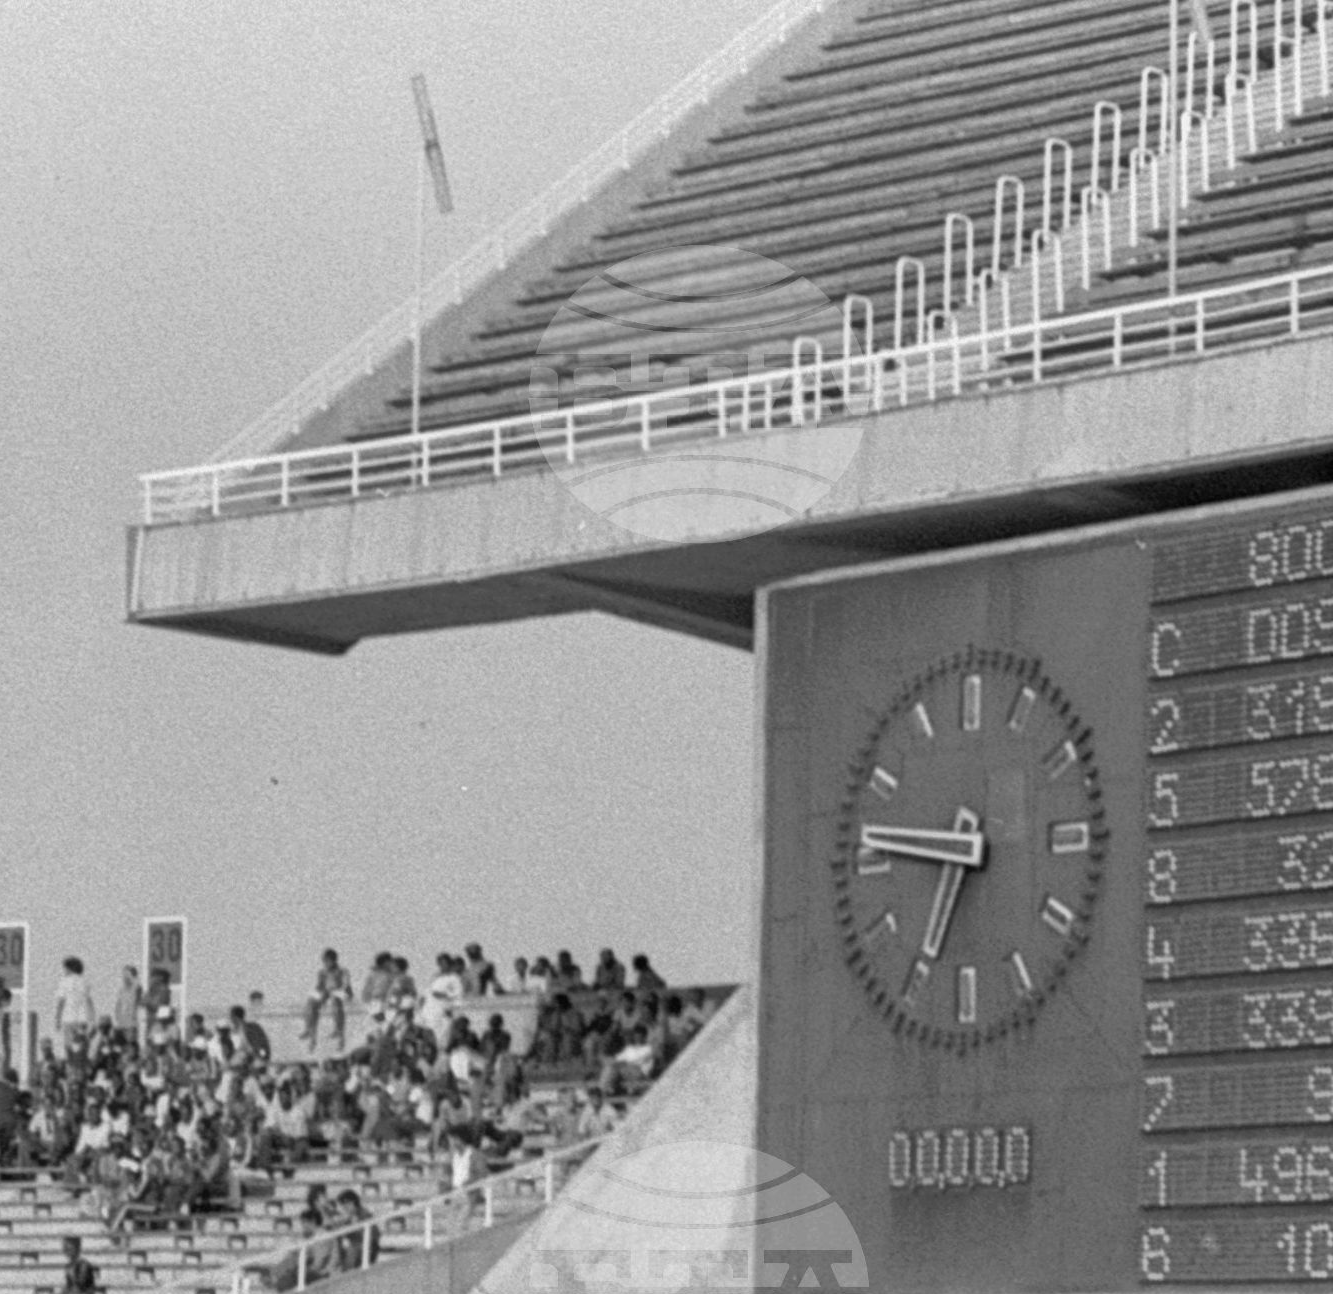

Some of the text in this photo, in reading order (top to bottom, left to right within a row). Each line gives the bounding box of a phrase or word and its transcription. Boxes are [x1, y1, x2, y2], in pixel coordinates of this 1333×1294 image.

[1151, 621, 1182, 677] C
[1150, 698, 1179, 754] 2
[1149, 772, 1179, 827] 5
[1148, 831, 1333, 903] 8 32
[1147, 925, 1175, 980] 4
[1145, 999, 1174, 1055] 3
[1144, 1066, 1333, 1132] 7 9
[1148, 1150, 1168, 1206] 1
[1142, 1226, 1171, 1281] 6
